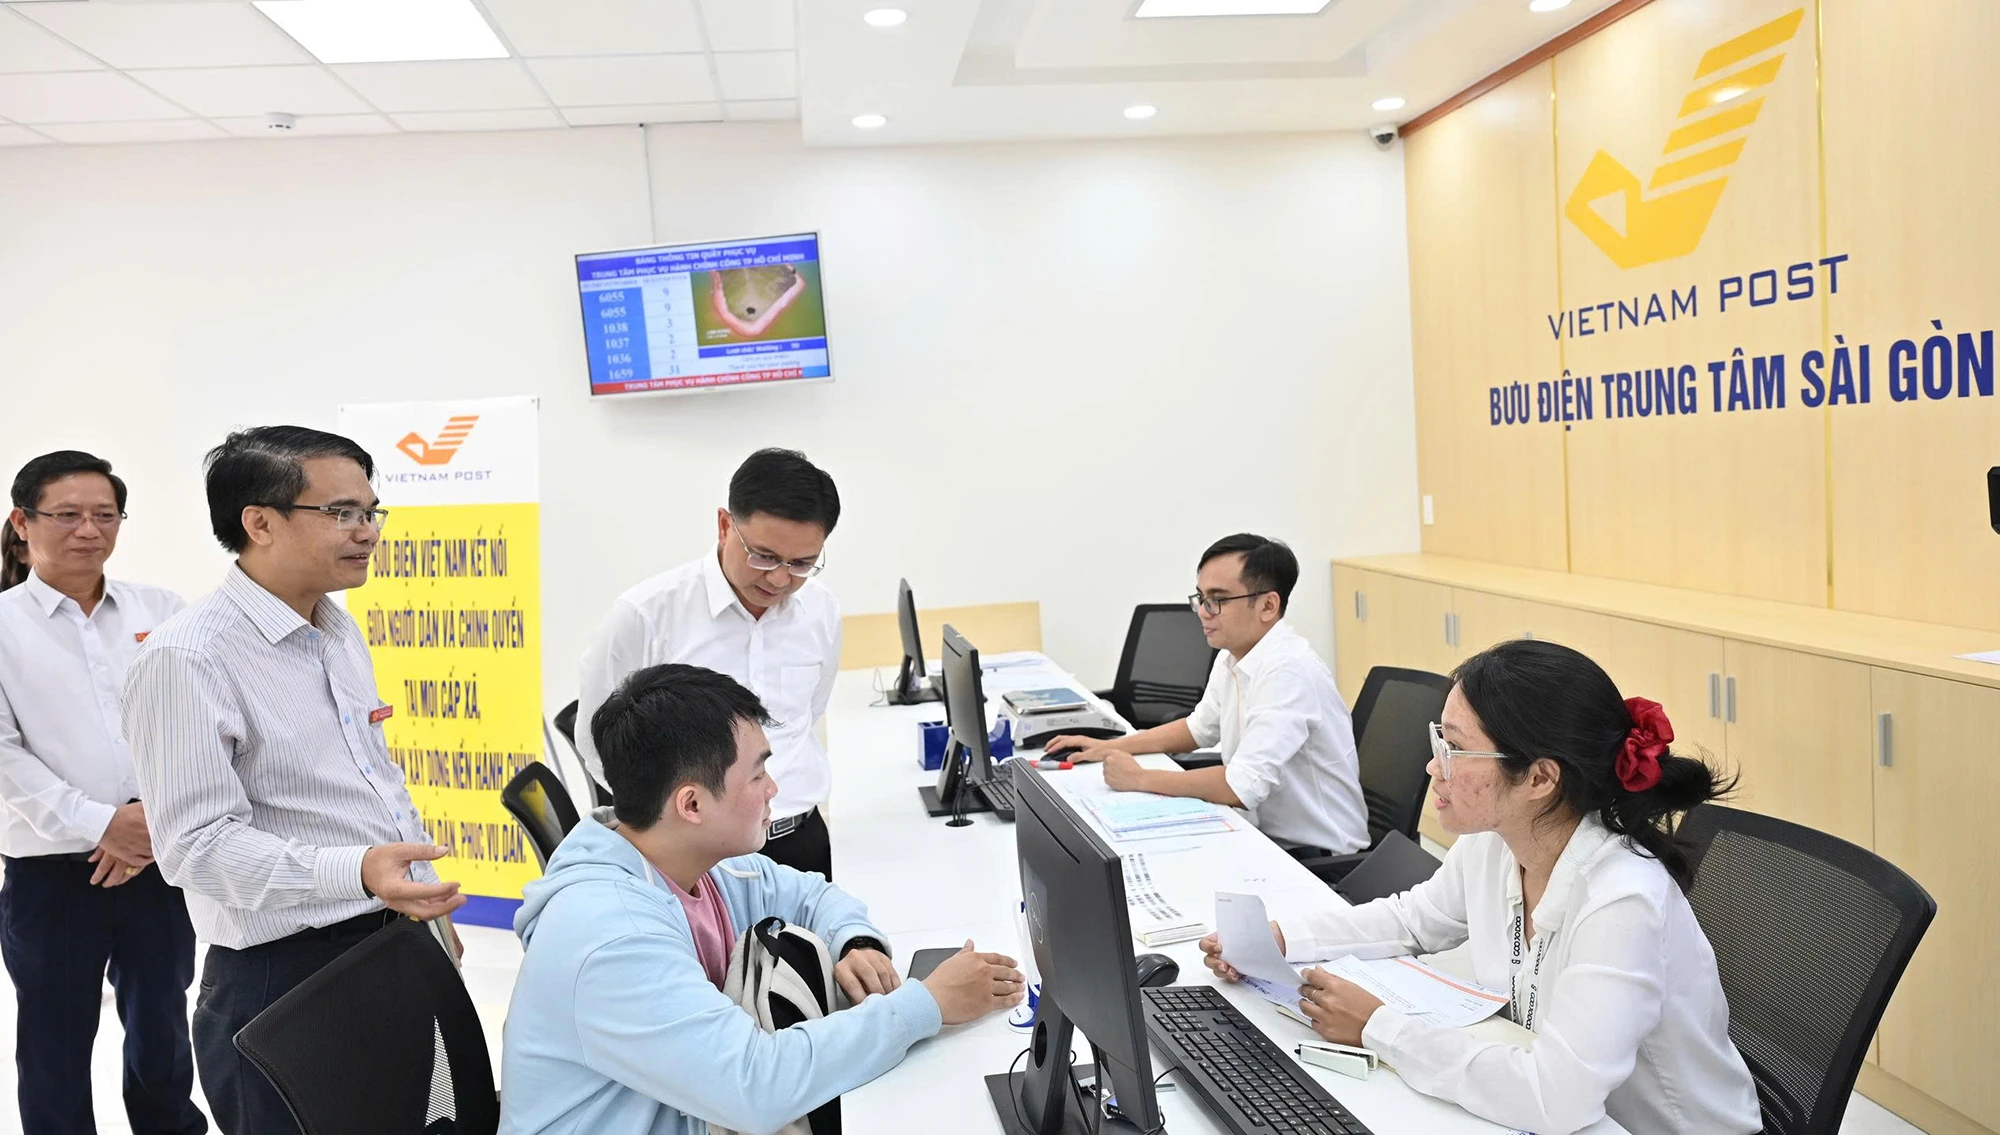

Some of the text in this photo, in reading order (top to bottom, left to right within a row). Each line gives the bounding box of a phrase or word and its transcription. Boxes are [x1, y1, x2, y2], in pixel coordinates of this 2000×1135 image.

[599, 290, 625, 302] 6055
[1548, 254, 1848, 340] VIETNAM POST
[601, 306, 626, 319] 6055
[604, 322, 629, 334] 1038
[606, 338, 629, 349] 1037
[607, 354, 632, 365] 1036
[609, 368, 633, 380] 1659
[1490, 319, 1994, 431] BƯU ĐIỆN TRUNG TÂM SÀI GÒN
[386, 470, 492, 482] VIETNAM POST
[421, 531, 441, 587] VIỆT
[445, 539, 467, 577] NAM
[470, 524, 487, 577] KẾT
[490, 523, 507, 577] NỐI
[419, 601, 439, 648] DÂN
[442, 600, 455, 648] VÀ
[459, 600, 489, 648] CHÍNH
[404, 679, 418, 726] TẠI
[420, 680, 438, 727] MỌI
[441, 665, 460, 718] CẤP
[475, 742, 503, 790] HÀNH
